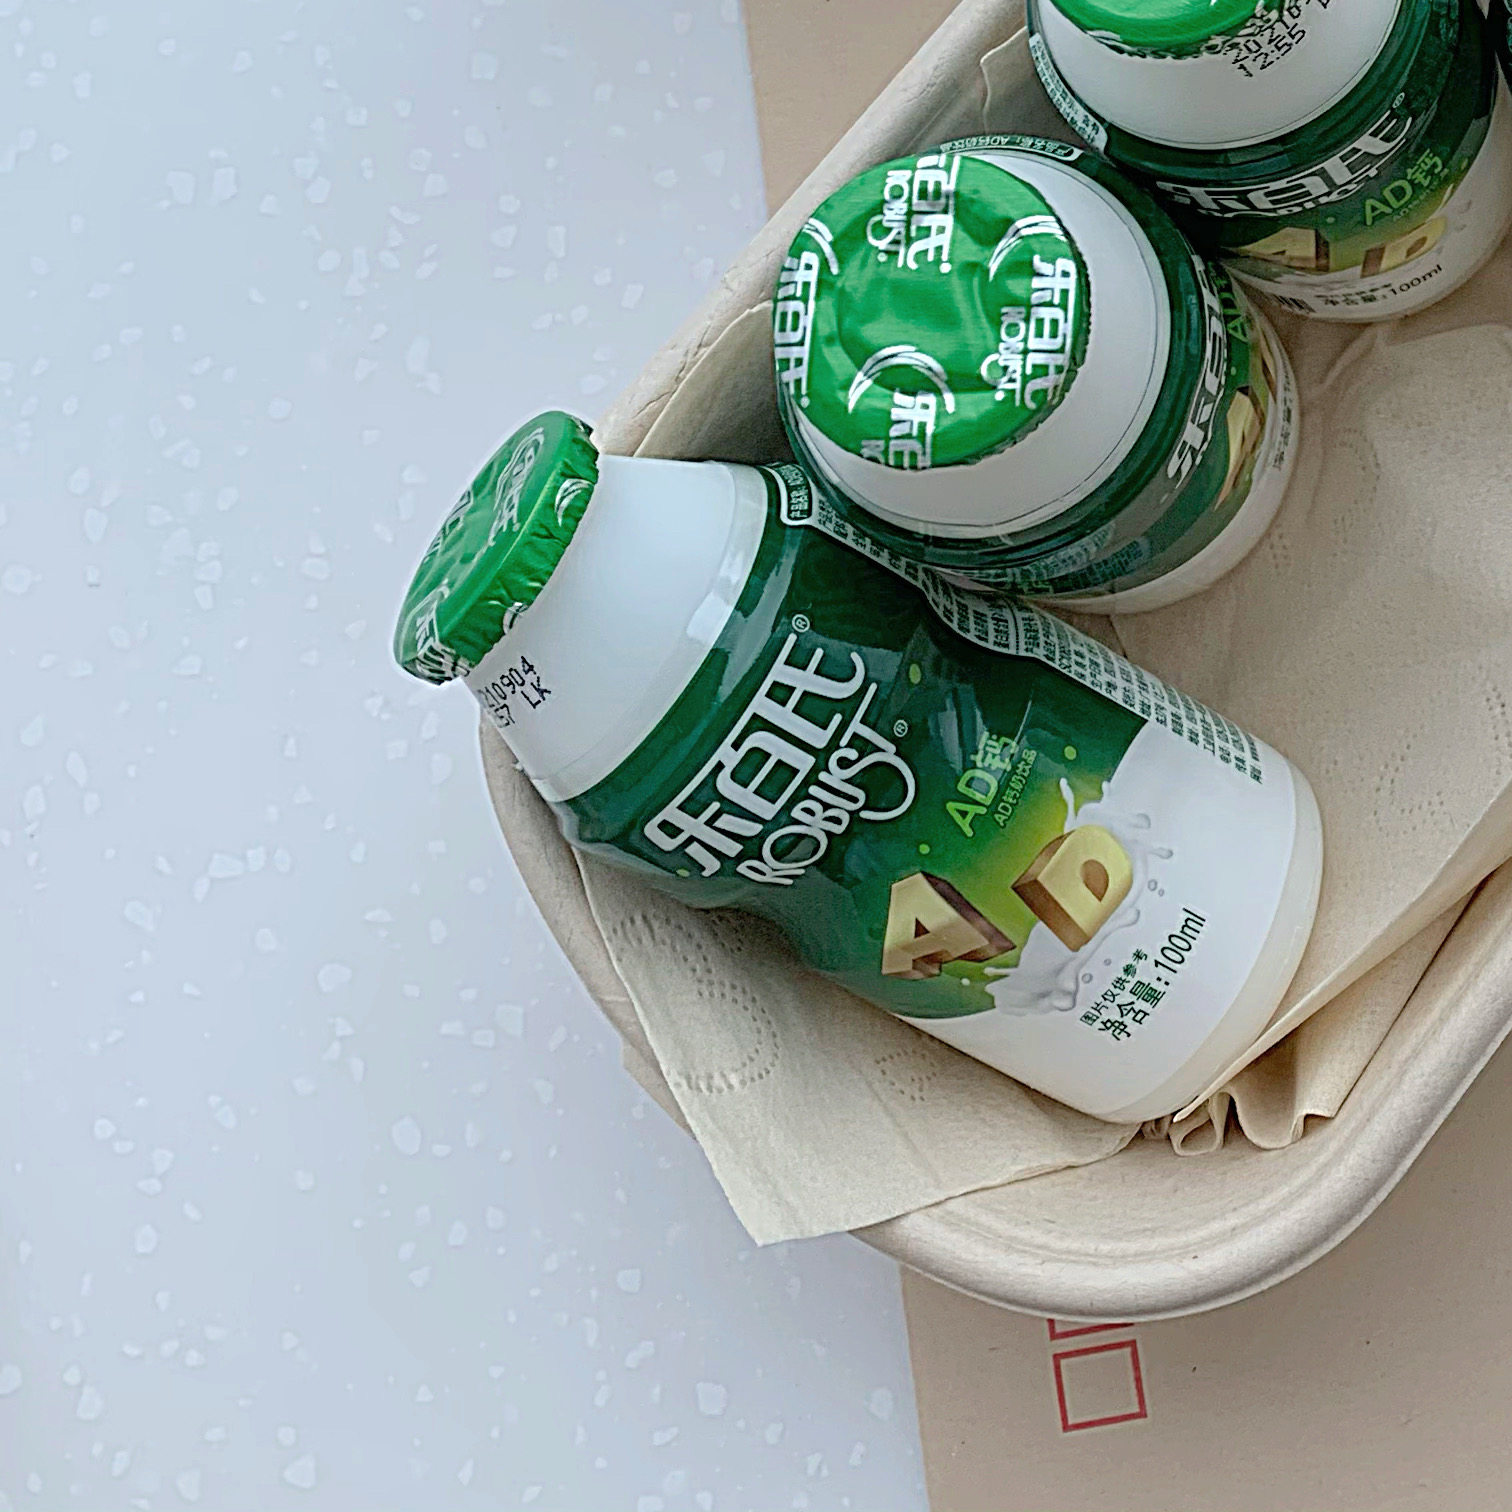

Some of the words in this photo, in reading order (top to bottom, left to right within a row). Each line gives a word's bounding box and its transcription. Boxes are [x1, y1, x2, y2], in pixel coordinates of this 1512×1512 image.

[1237, 23, 1306, 77] 12:55
[1365, 149, 1444, 226] AD钙
[520, 676, 552, 709] LK
[643, 634, 865, 878] 乐百氏
[735, 682, 917, 886] ROBUST
[946, 730, 1019, 837] AD钙
[993, 748, 1038, 827] AD钙奶饮品
[1079, 947, 1149, 1027] 图片仅供参考
[1097, 907, 1208, 1042] 净含量：100ml
